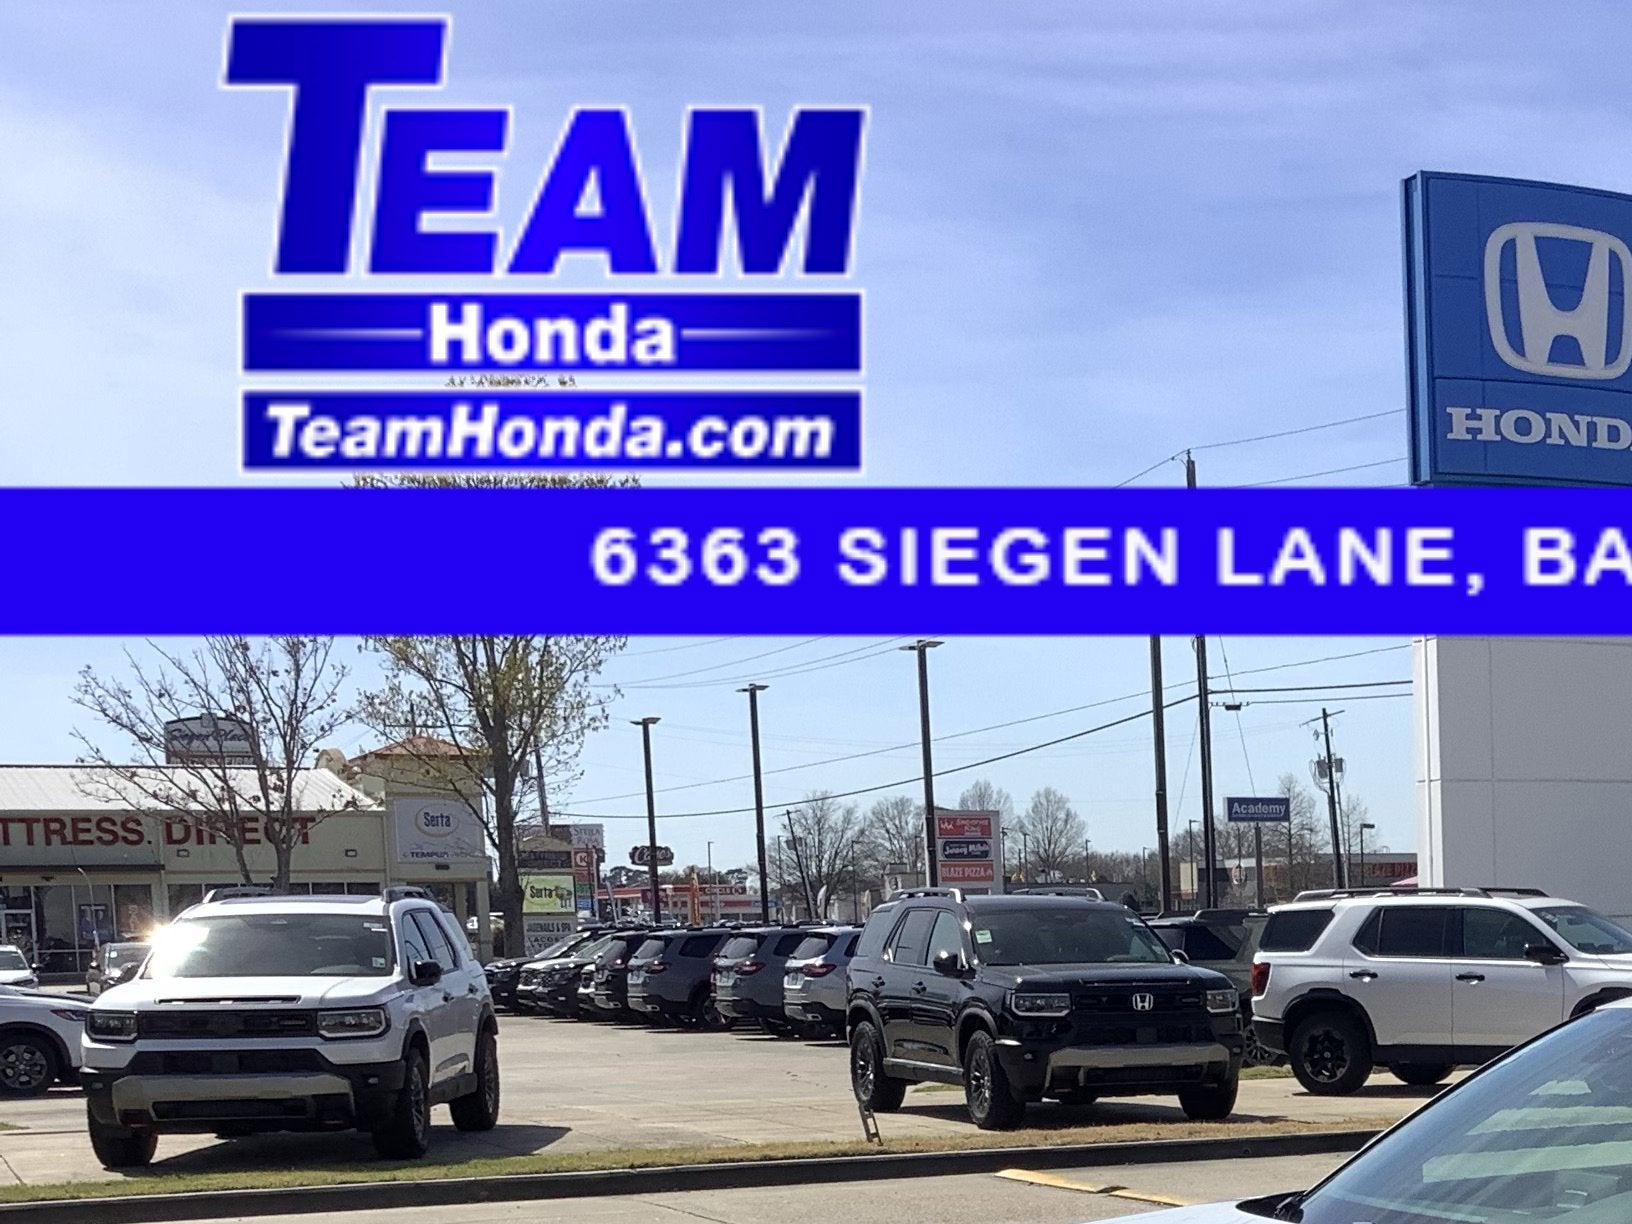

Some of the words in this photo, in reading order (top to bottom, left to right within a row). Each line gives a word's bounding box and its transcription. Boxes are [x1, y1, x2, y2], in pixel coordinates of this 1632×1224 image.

[1232, 802, 1286, 817] Academy
[423, 812, 451, 827] Serta
[941, 867, 963, 878] BLAZE
[964, 867, 986, 878] PIZZA
